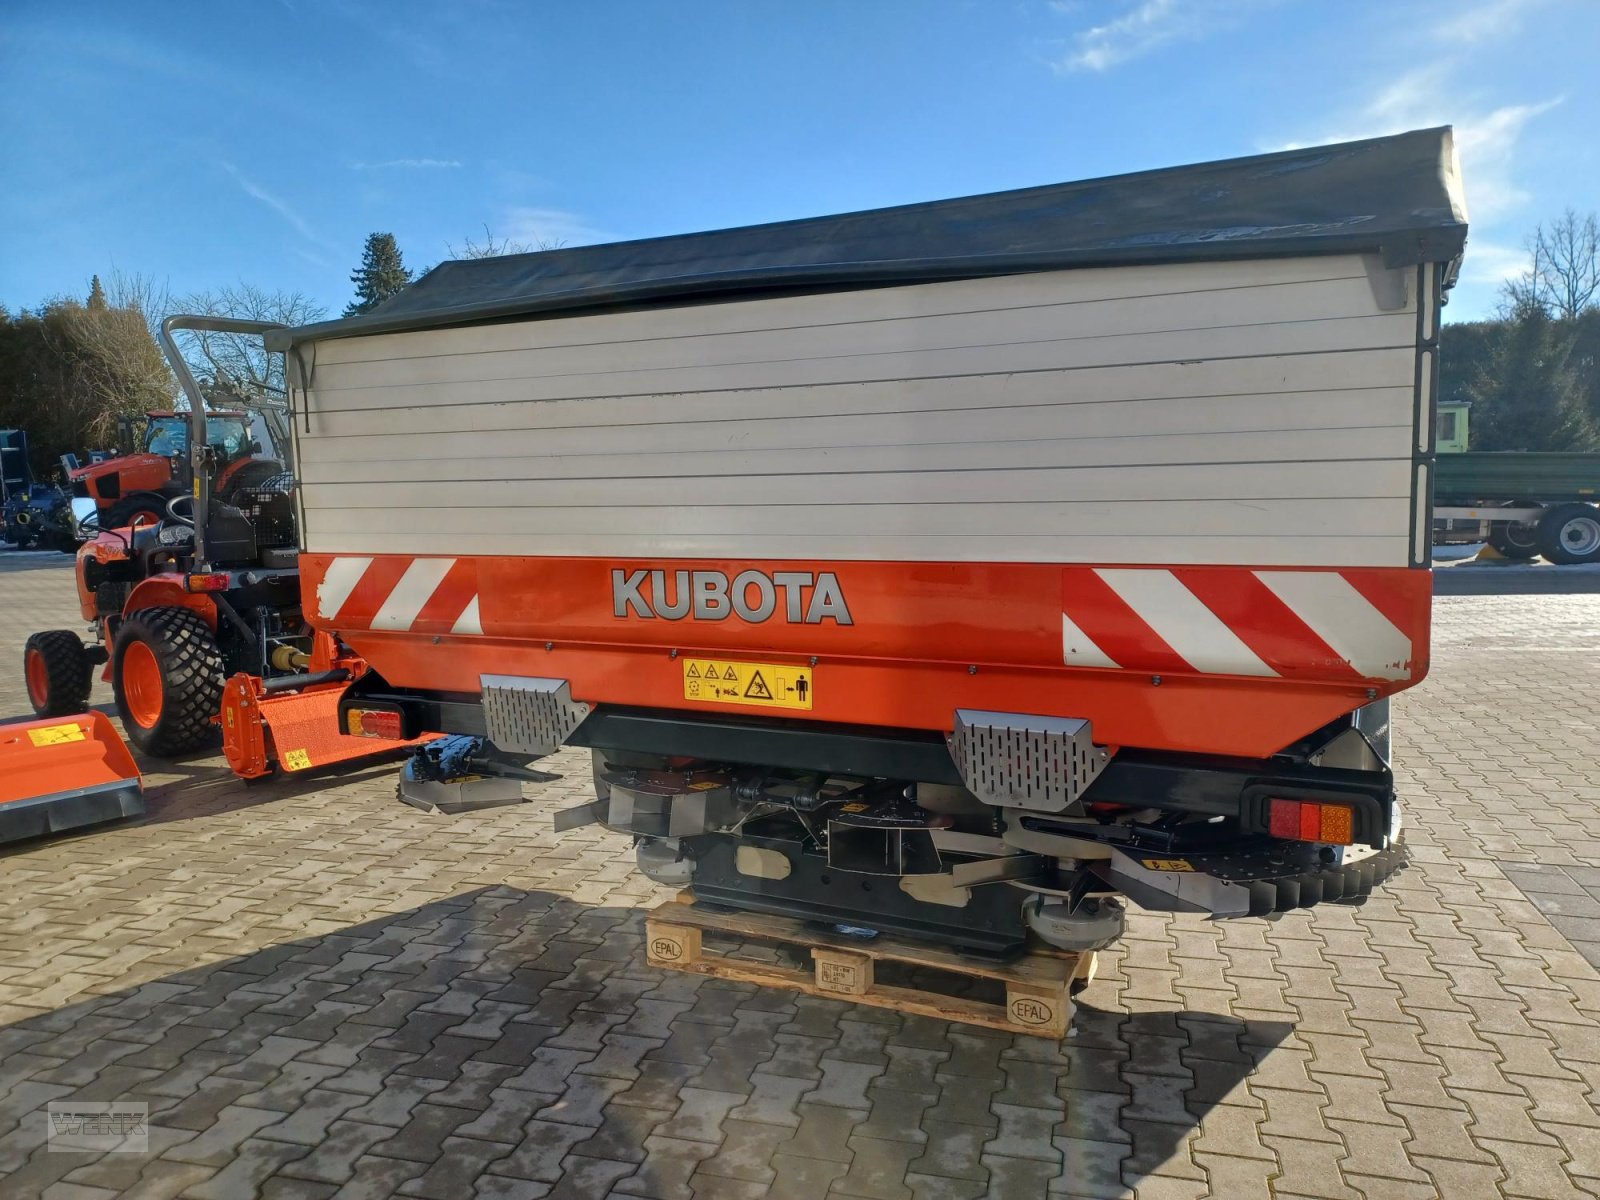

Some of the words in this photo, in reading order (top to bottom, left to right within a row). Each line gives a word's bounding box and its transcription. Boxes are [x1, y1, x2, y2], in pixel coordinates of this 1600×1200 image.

[611, 569, 854, 625] KUBOTA
[655, 941, 679, 957] EPAL
[1017, 1002, 1047, 1021] EPAL
